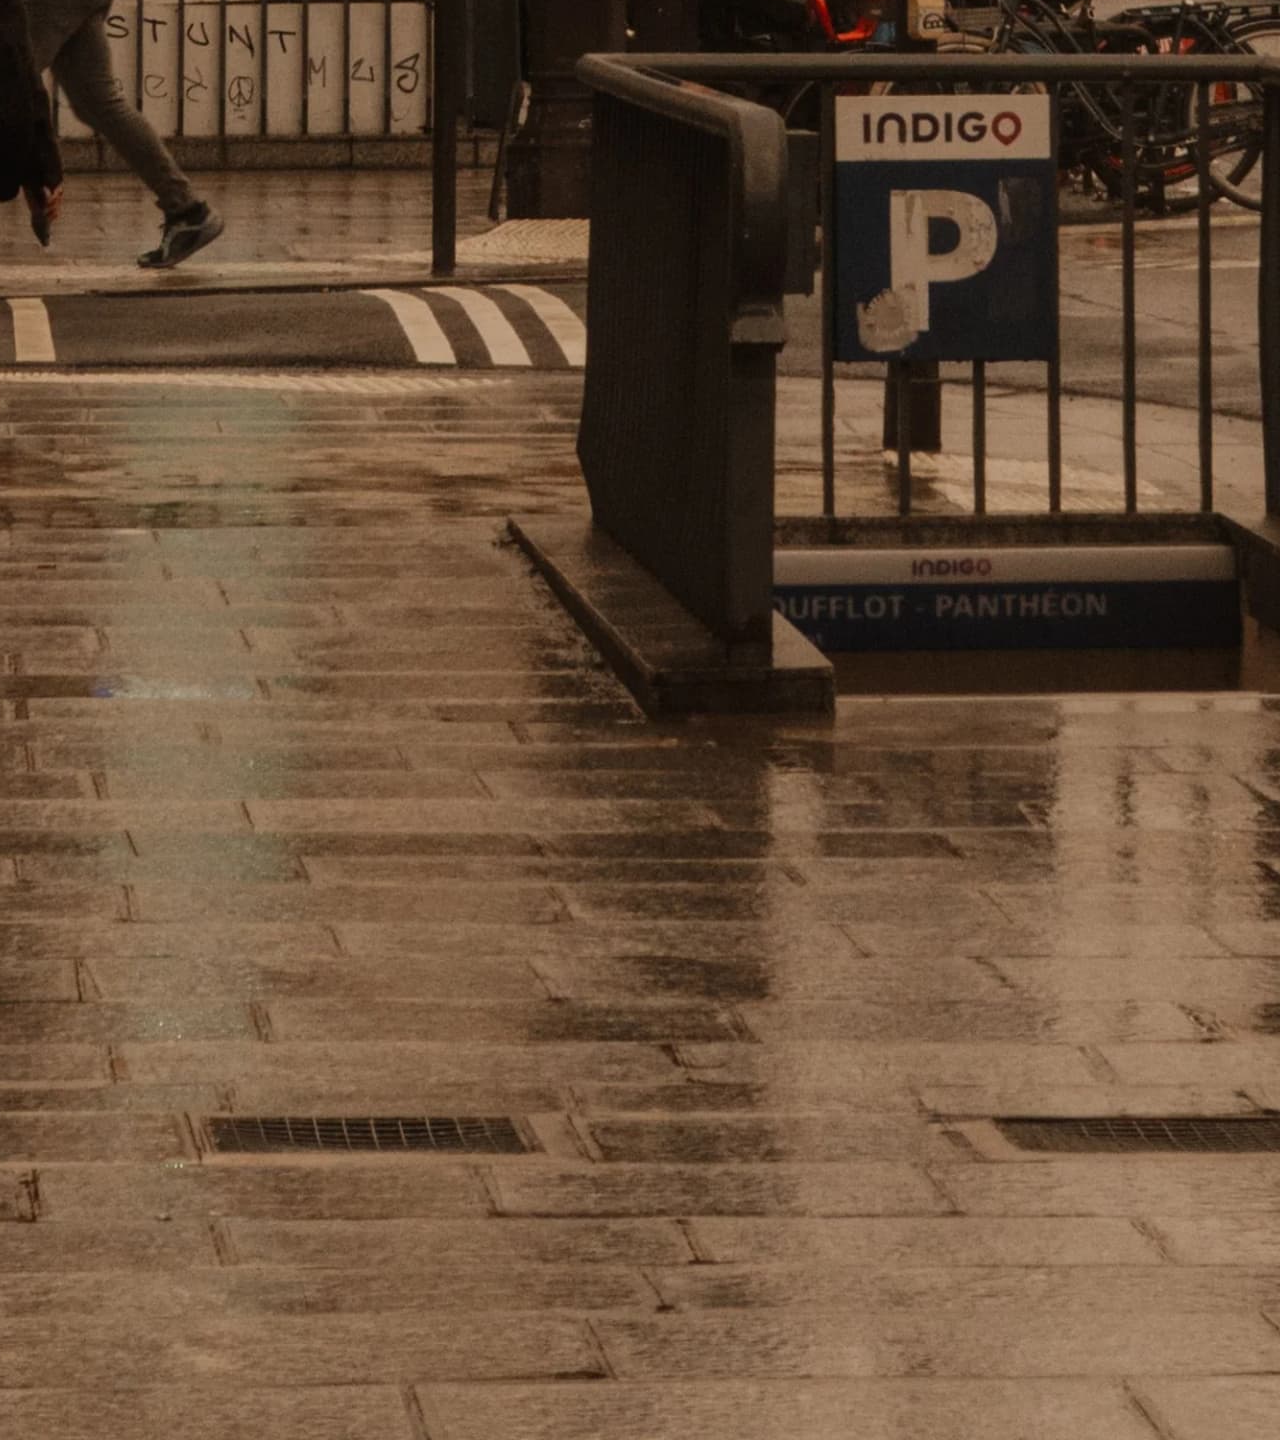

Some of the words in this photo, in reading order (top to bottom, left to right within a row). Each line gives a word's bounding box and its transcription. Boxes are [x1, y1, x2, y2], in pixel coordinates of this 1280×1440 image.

[862, 111, 1023, 146] INDIGO
[889, 188, 999, 332] P
[912, 558, 993, 577] INDIGO
[936, 587, 1108, 617] PANTHÉON
